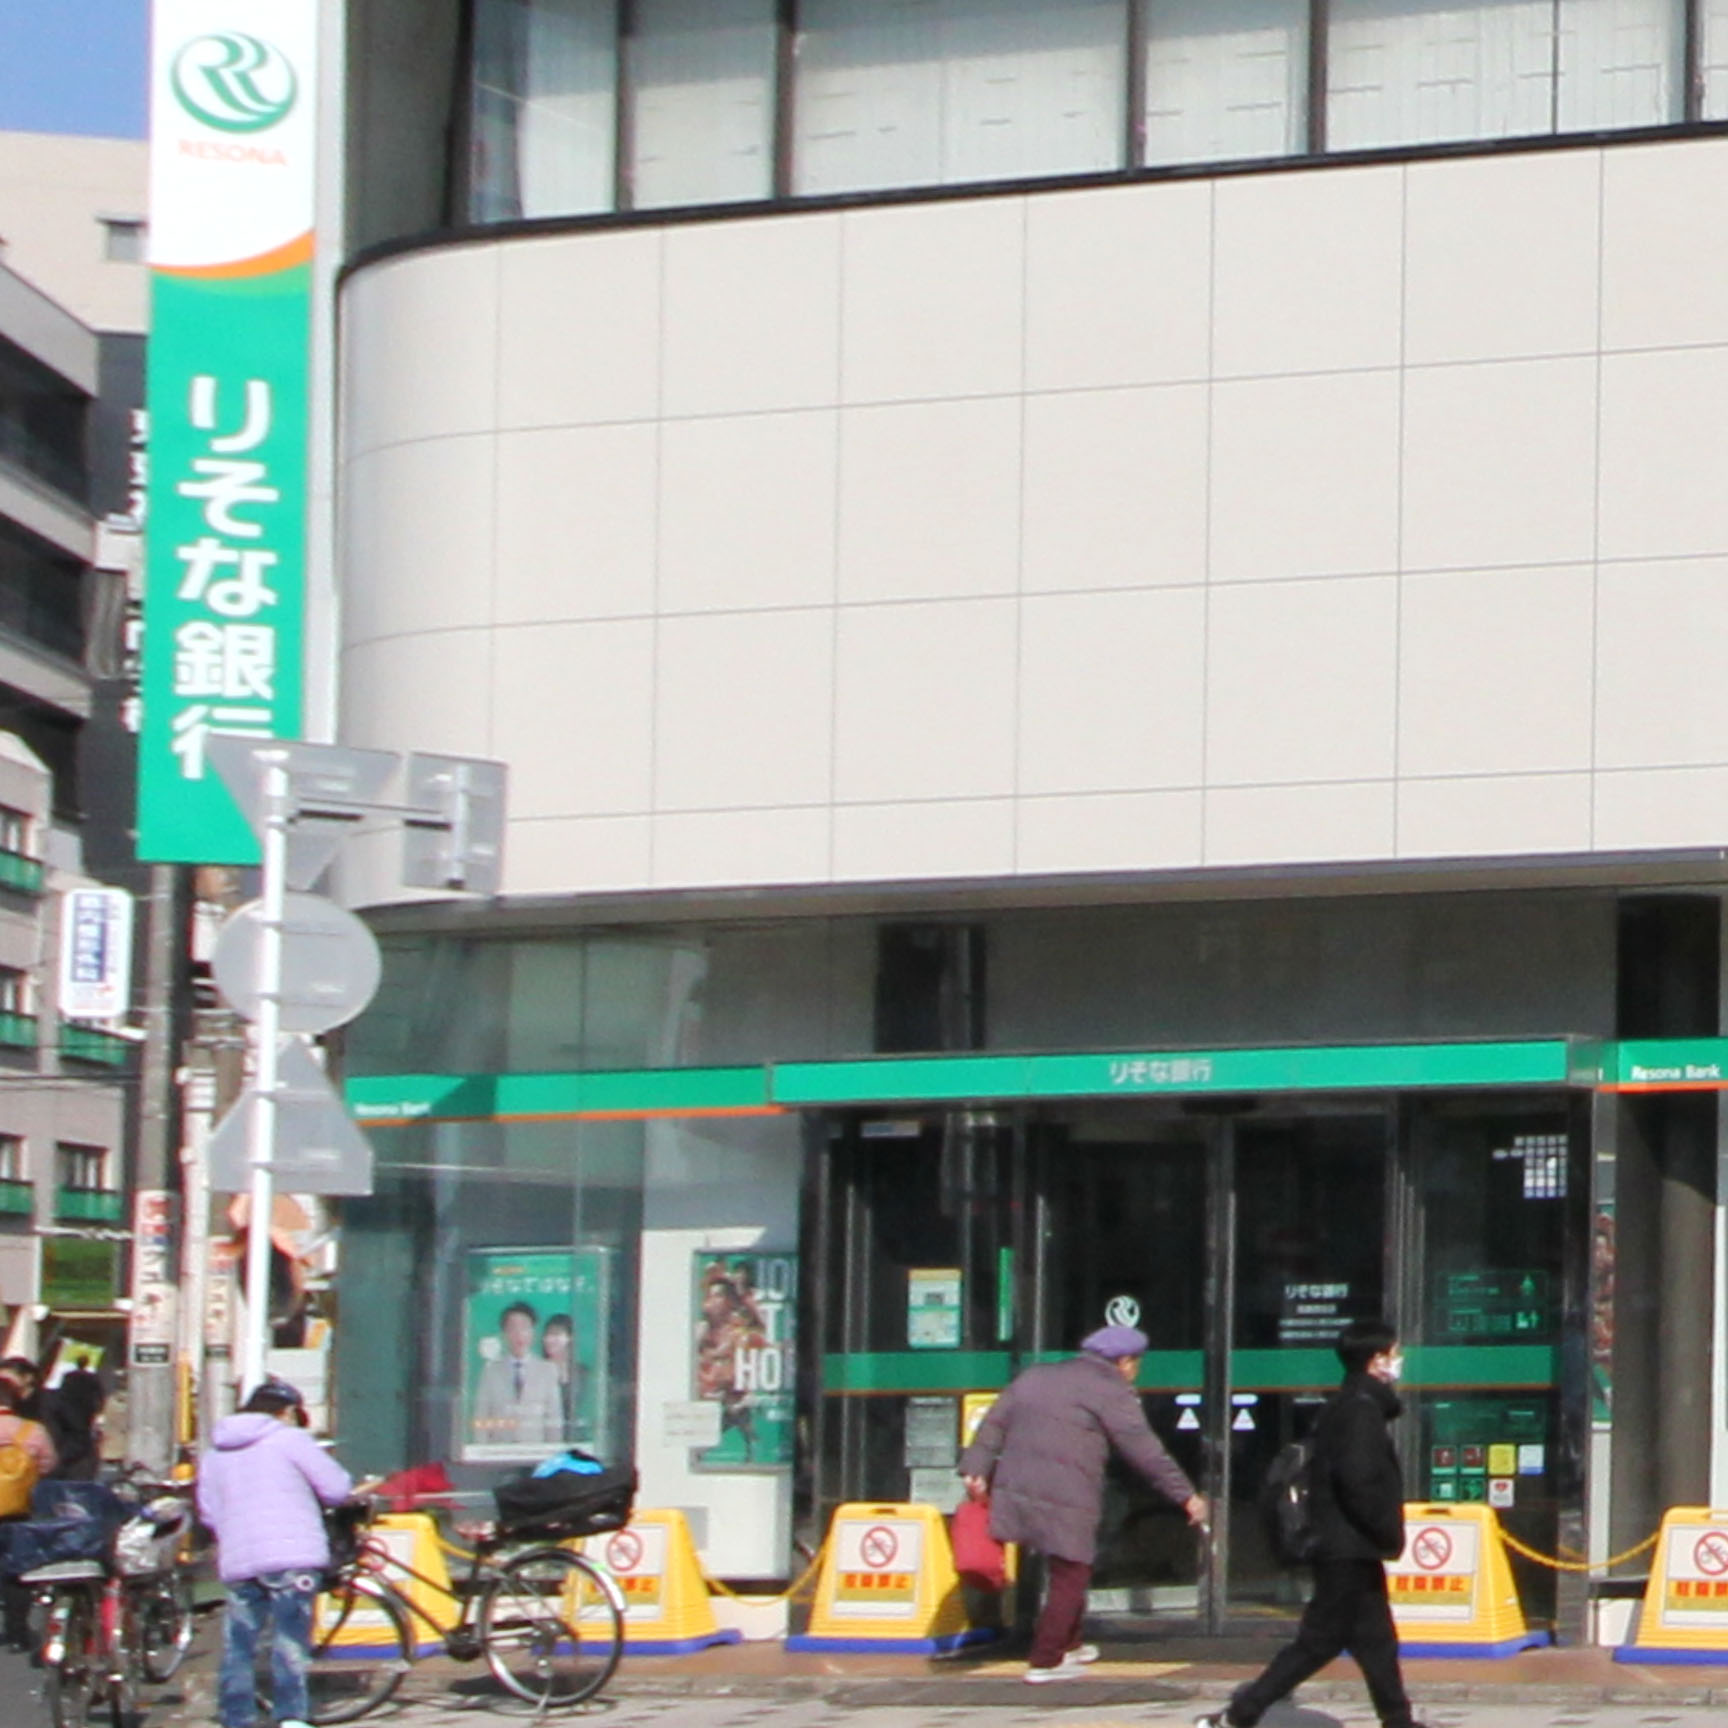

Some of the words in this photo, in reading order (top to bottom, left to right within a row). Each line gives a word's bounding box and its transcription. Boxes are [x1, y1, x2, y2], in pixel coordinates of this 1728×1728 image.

[178, 138, 289, 166] RESONA
[1109, 1058, 1213, 1085] りそな銀行
[1632, 1065, 1681, 1081] Resona
[1685, 1064, 1720, 1079] Bank
